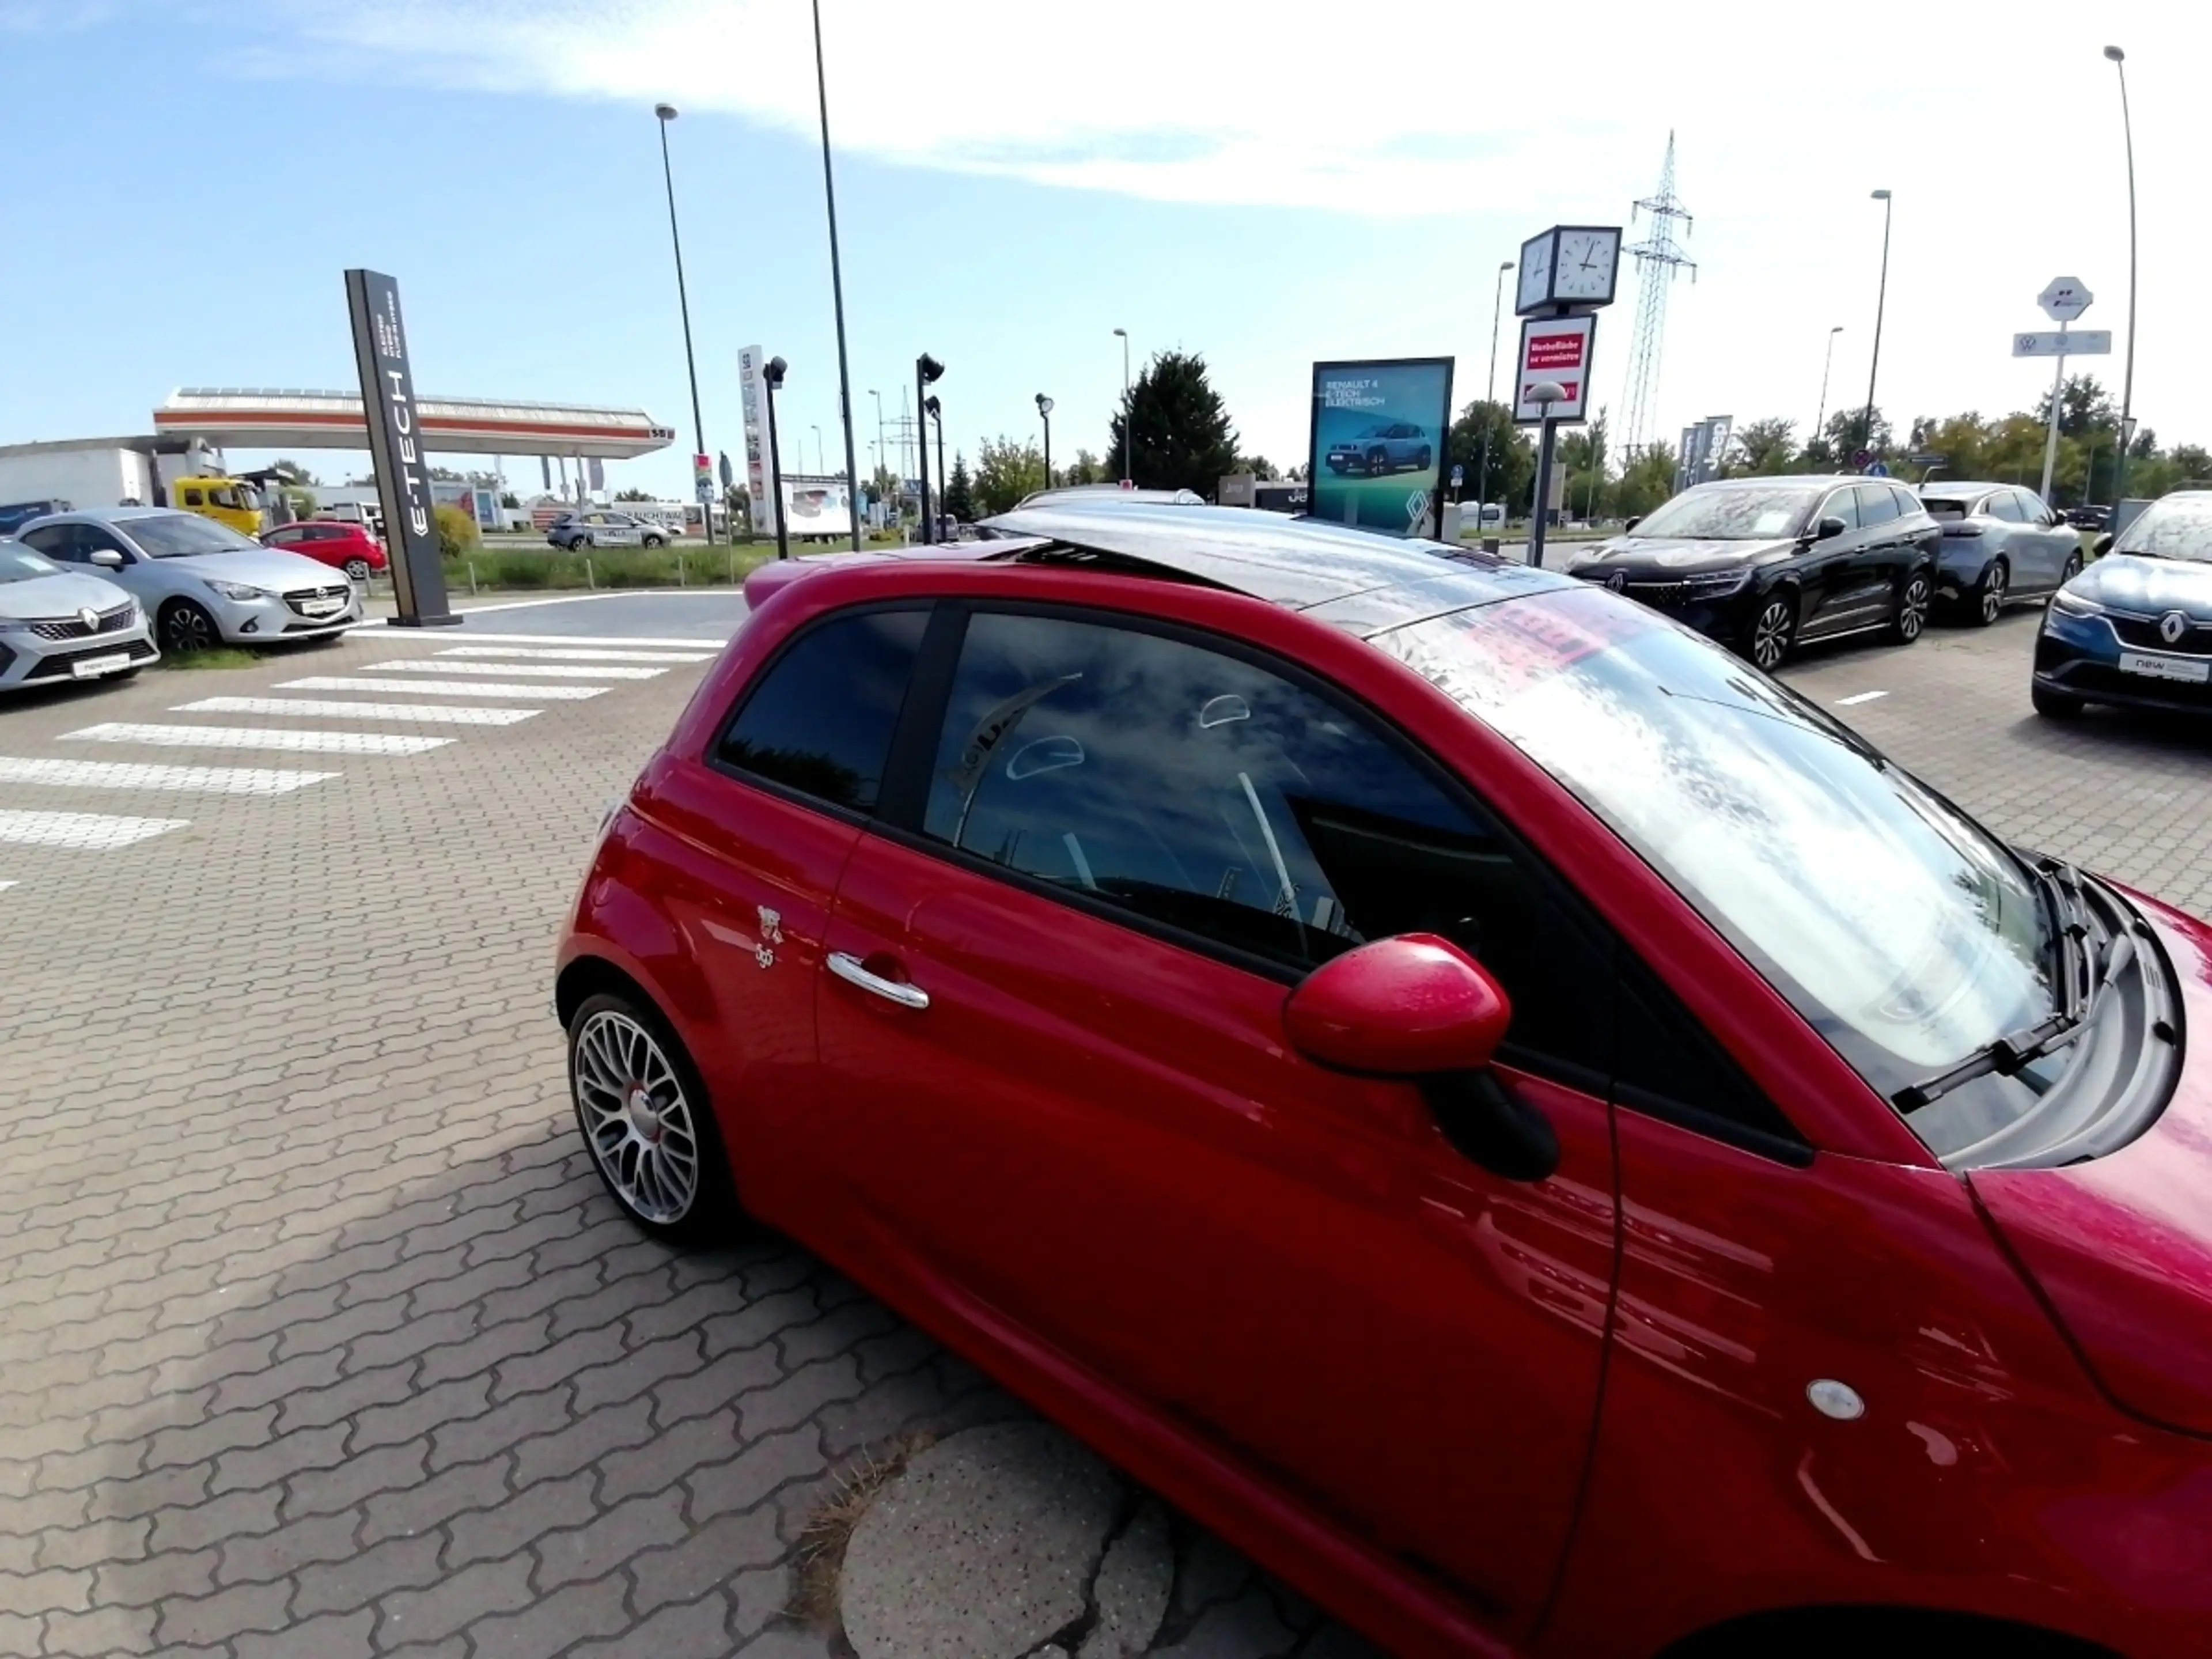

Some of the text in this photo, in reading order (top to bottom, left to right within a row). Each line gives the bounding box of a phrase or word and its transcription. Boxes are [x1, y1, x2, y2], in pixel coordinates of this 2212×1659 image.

[1541, 352, 1579, 362] vermieten
[1326, 380, 1370, 389] RENAULT
[1325, 396, 1385, 407] ELEKTRISCH
[1703, 422, 1728, 471] Jeep
[387, 370, 429, 537] E-TECH
[2136, 660, 2165, 670] new
